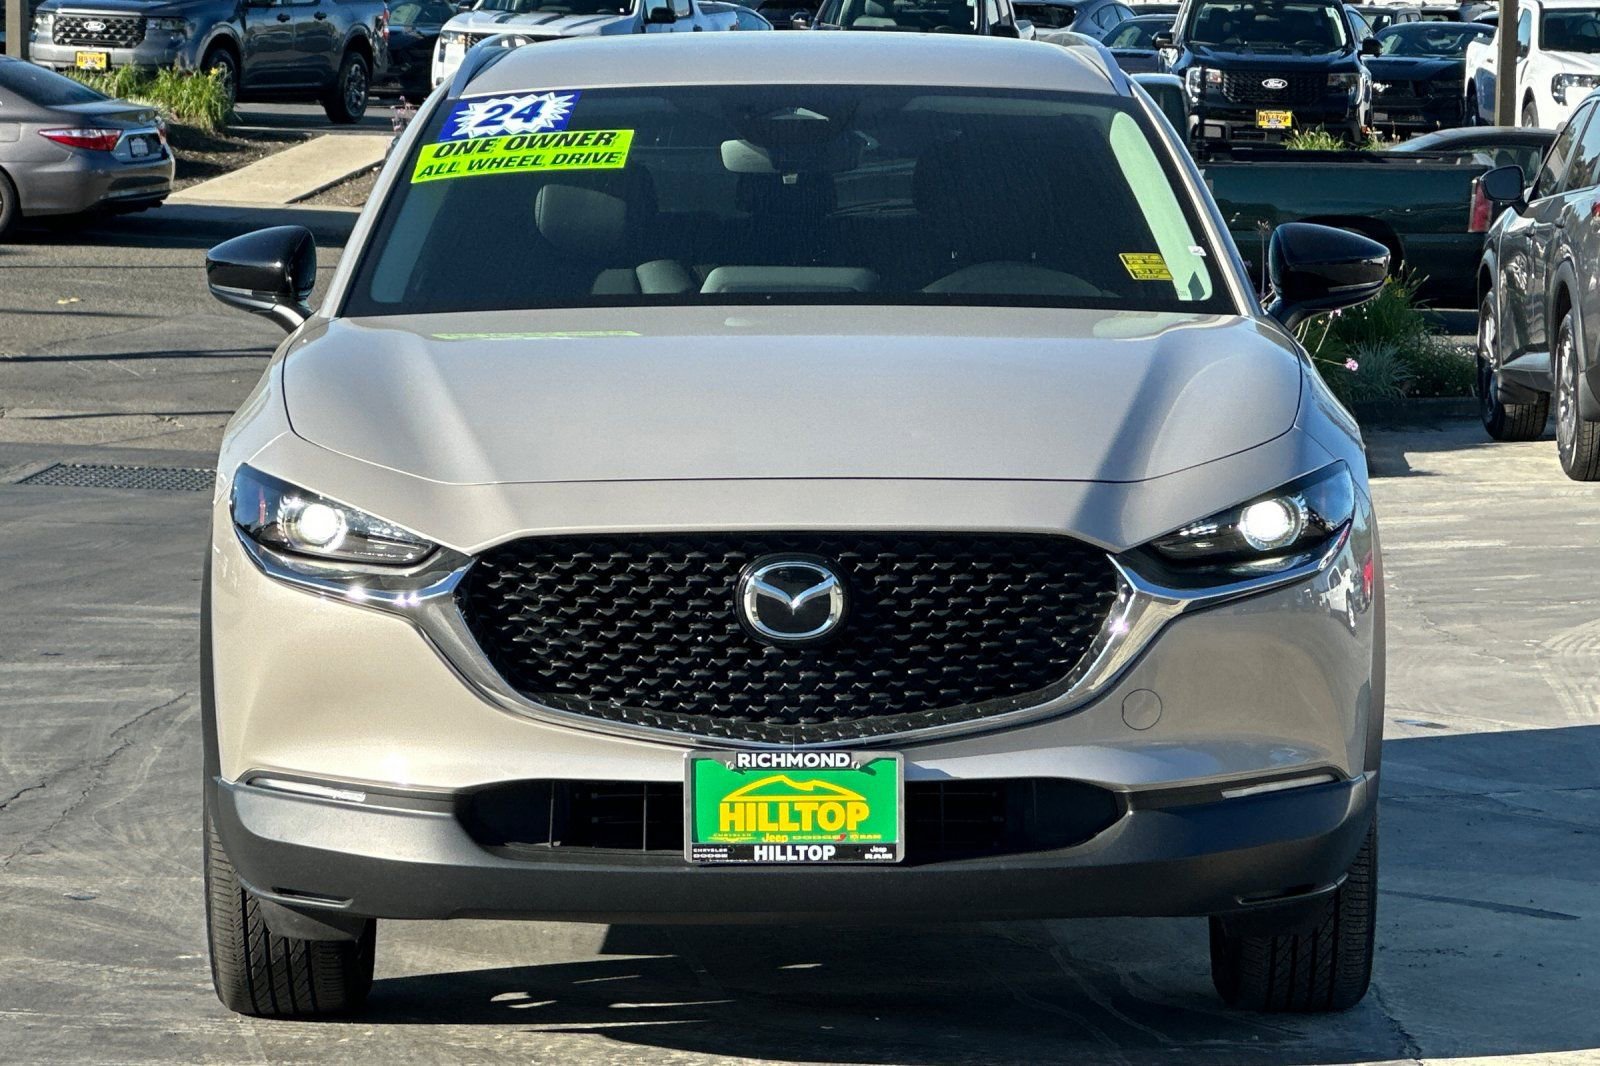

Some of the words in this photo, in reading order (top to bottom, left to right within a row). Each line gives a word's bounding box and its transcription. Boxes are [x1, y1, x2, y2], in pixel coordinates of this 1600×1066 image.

[472, 100, 541, 127] 24
[432, 138, 496, 159] ONE
[503, 131, 618, 152] OWNER
[416, 161, 458, 178] ALL
[467, 153, 542, 172] WHEEL
[549, 151, 622, 165] DRIVE
[737, 753, 851, 768] RICHMOND
[719, 802, 870, 832] HILLTOP
[762, 833, 788, 843] Jeep
[753, 845, 836, 861] HILLTOP
[869, 845, 887, 853] Jeep
